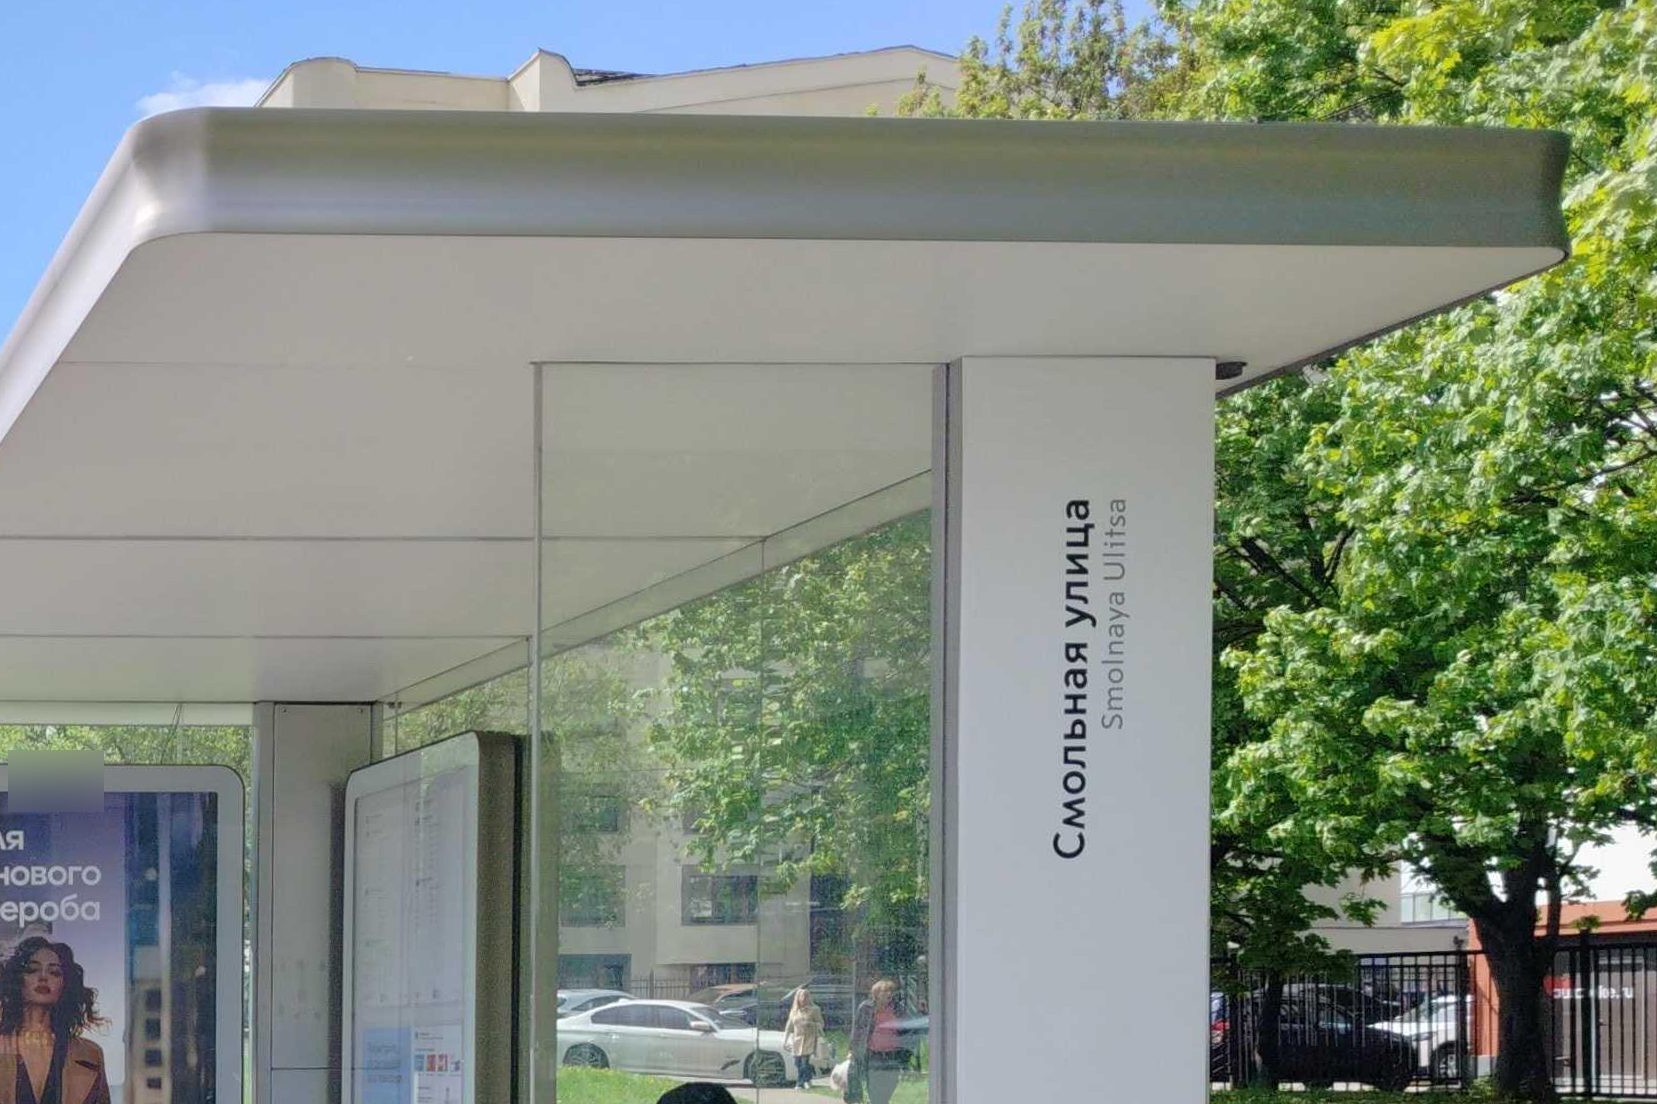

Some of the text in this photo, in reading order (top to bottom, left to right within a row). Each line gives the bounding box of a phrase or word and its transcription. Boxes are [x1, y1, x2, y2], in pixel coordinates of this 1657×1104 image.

[1053, 499, 1097, 859] Смольная улица
[1101, 499, 1130, 730] Smolnaya Ulitsa
